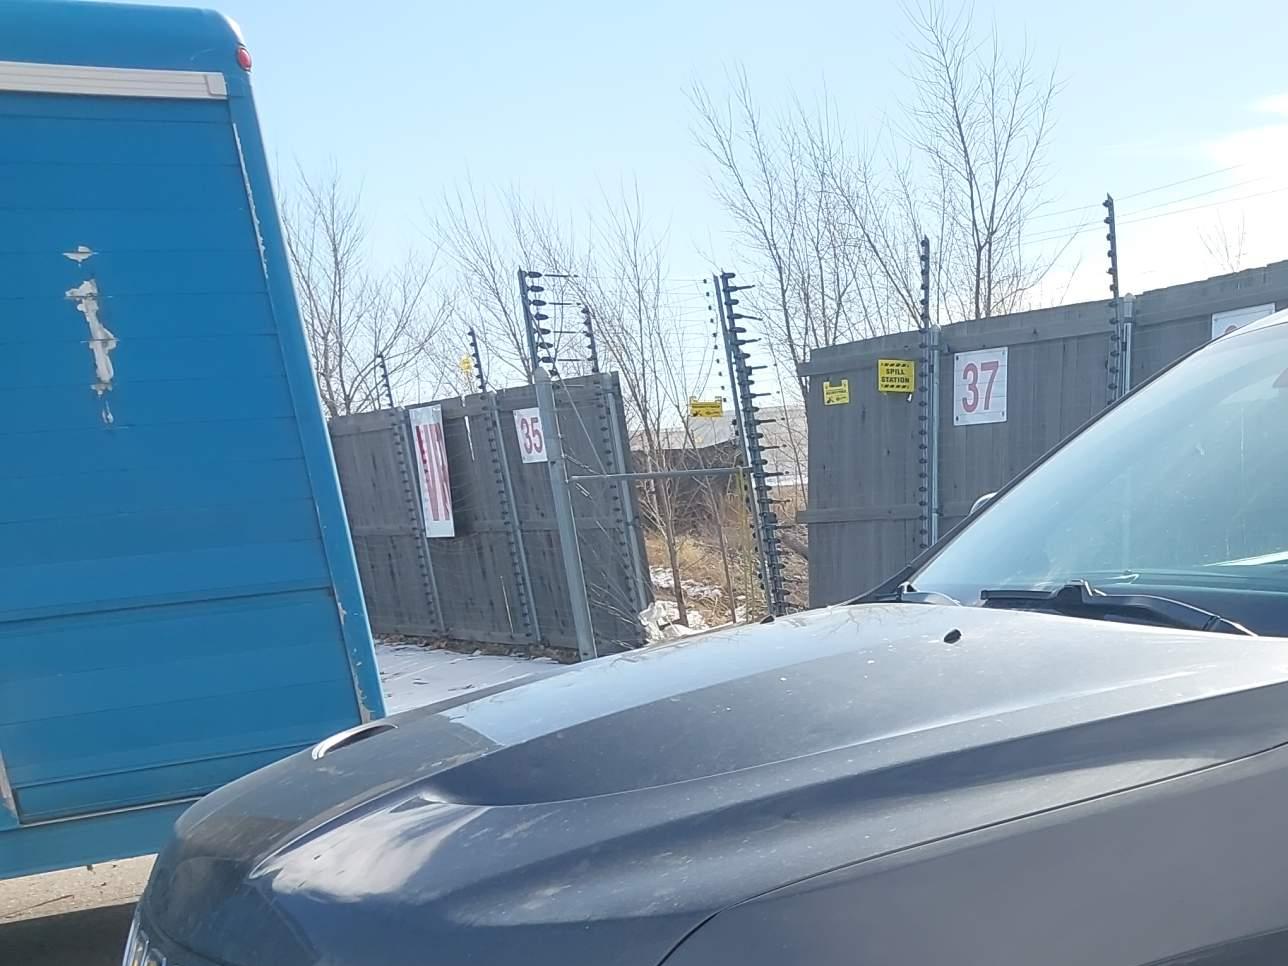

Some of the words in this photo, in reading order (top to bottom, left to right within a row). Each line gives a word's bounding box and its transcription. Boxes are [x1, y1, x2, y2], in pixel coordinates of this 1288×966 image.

[885, 368, 905, 376] SPILL
[962, 360, 999, 413] 37
[520, 416, 544, 455] 35
